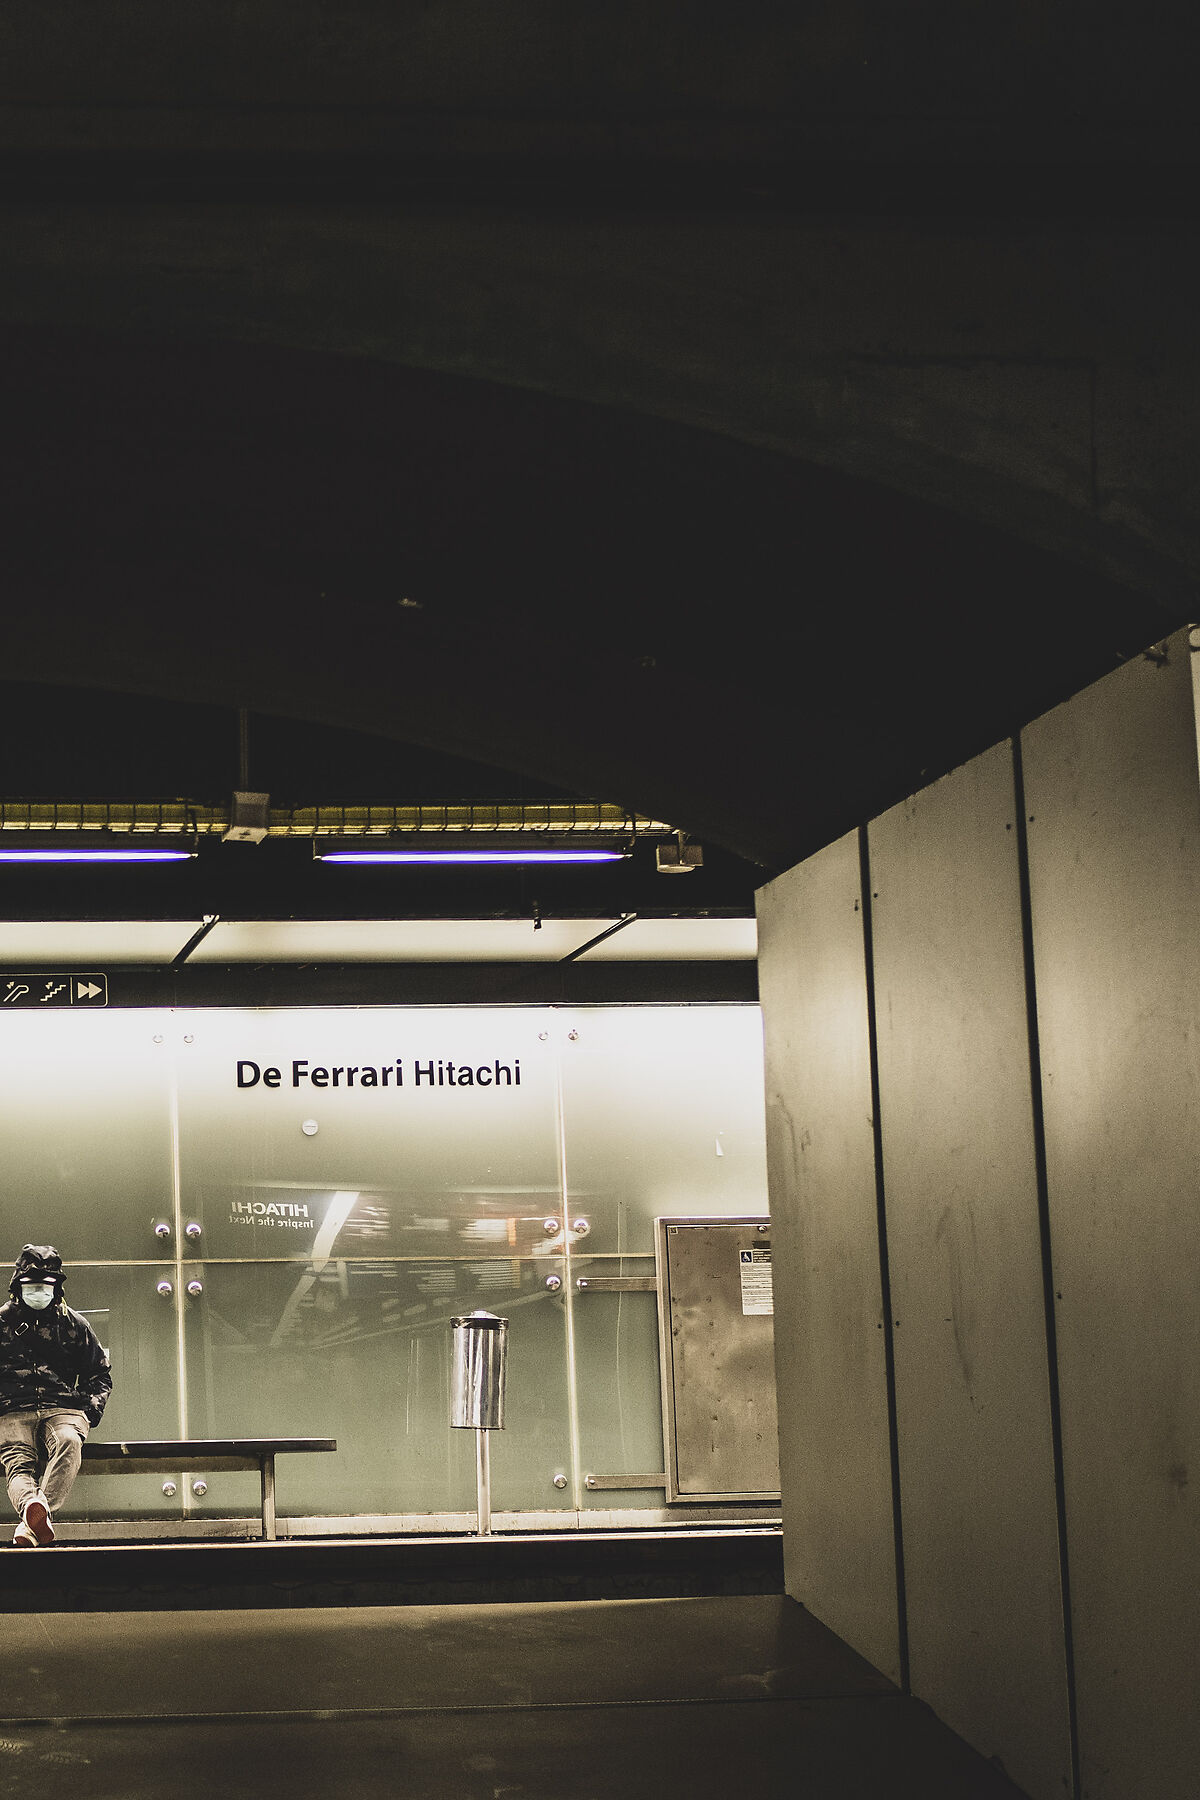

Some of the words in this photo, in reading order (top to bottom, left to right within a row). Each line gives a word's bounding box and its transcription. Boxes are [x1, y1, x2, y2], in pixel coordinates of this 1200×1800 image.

[236, 1060, 282, 1088] De
[292, 1058, 403, 1088] Ferrari
[414, 1059, 521, 1086] Hitachi
